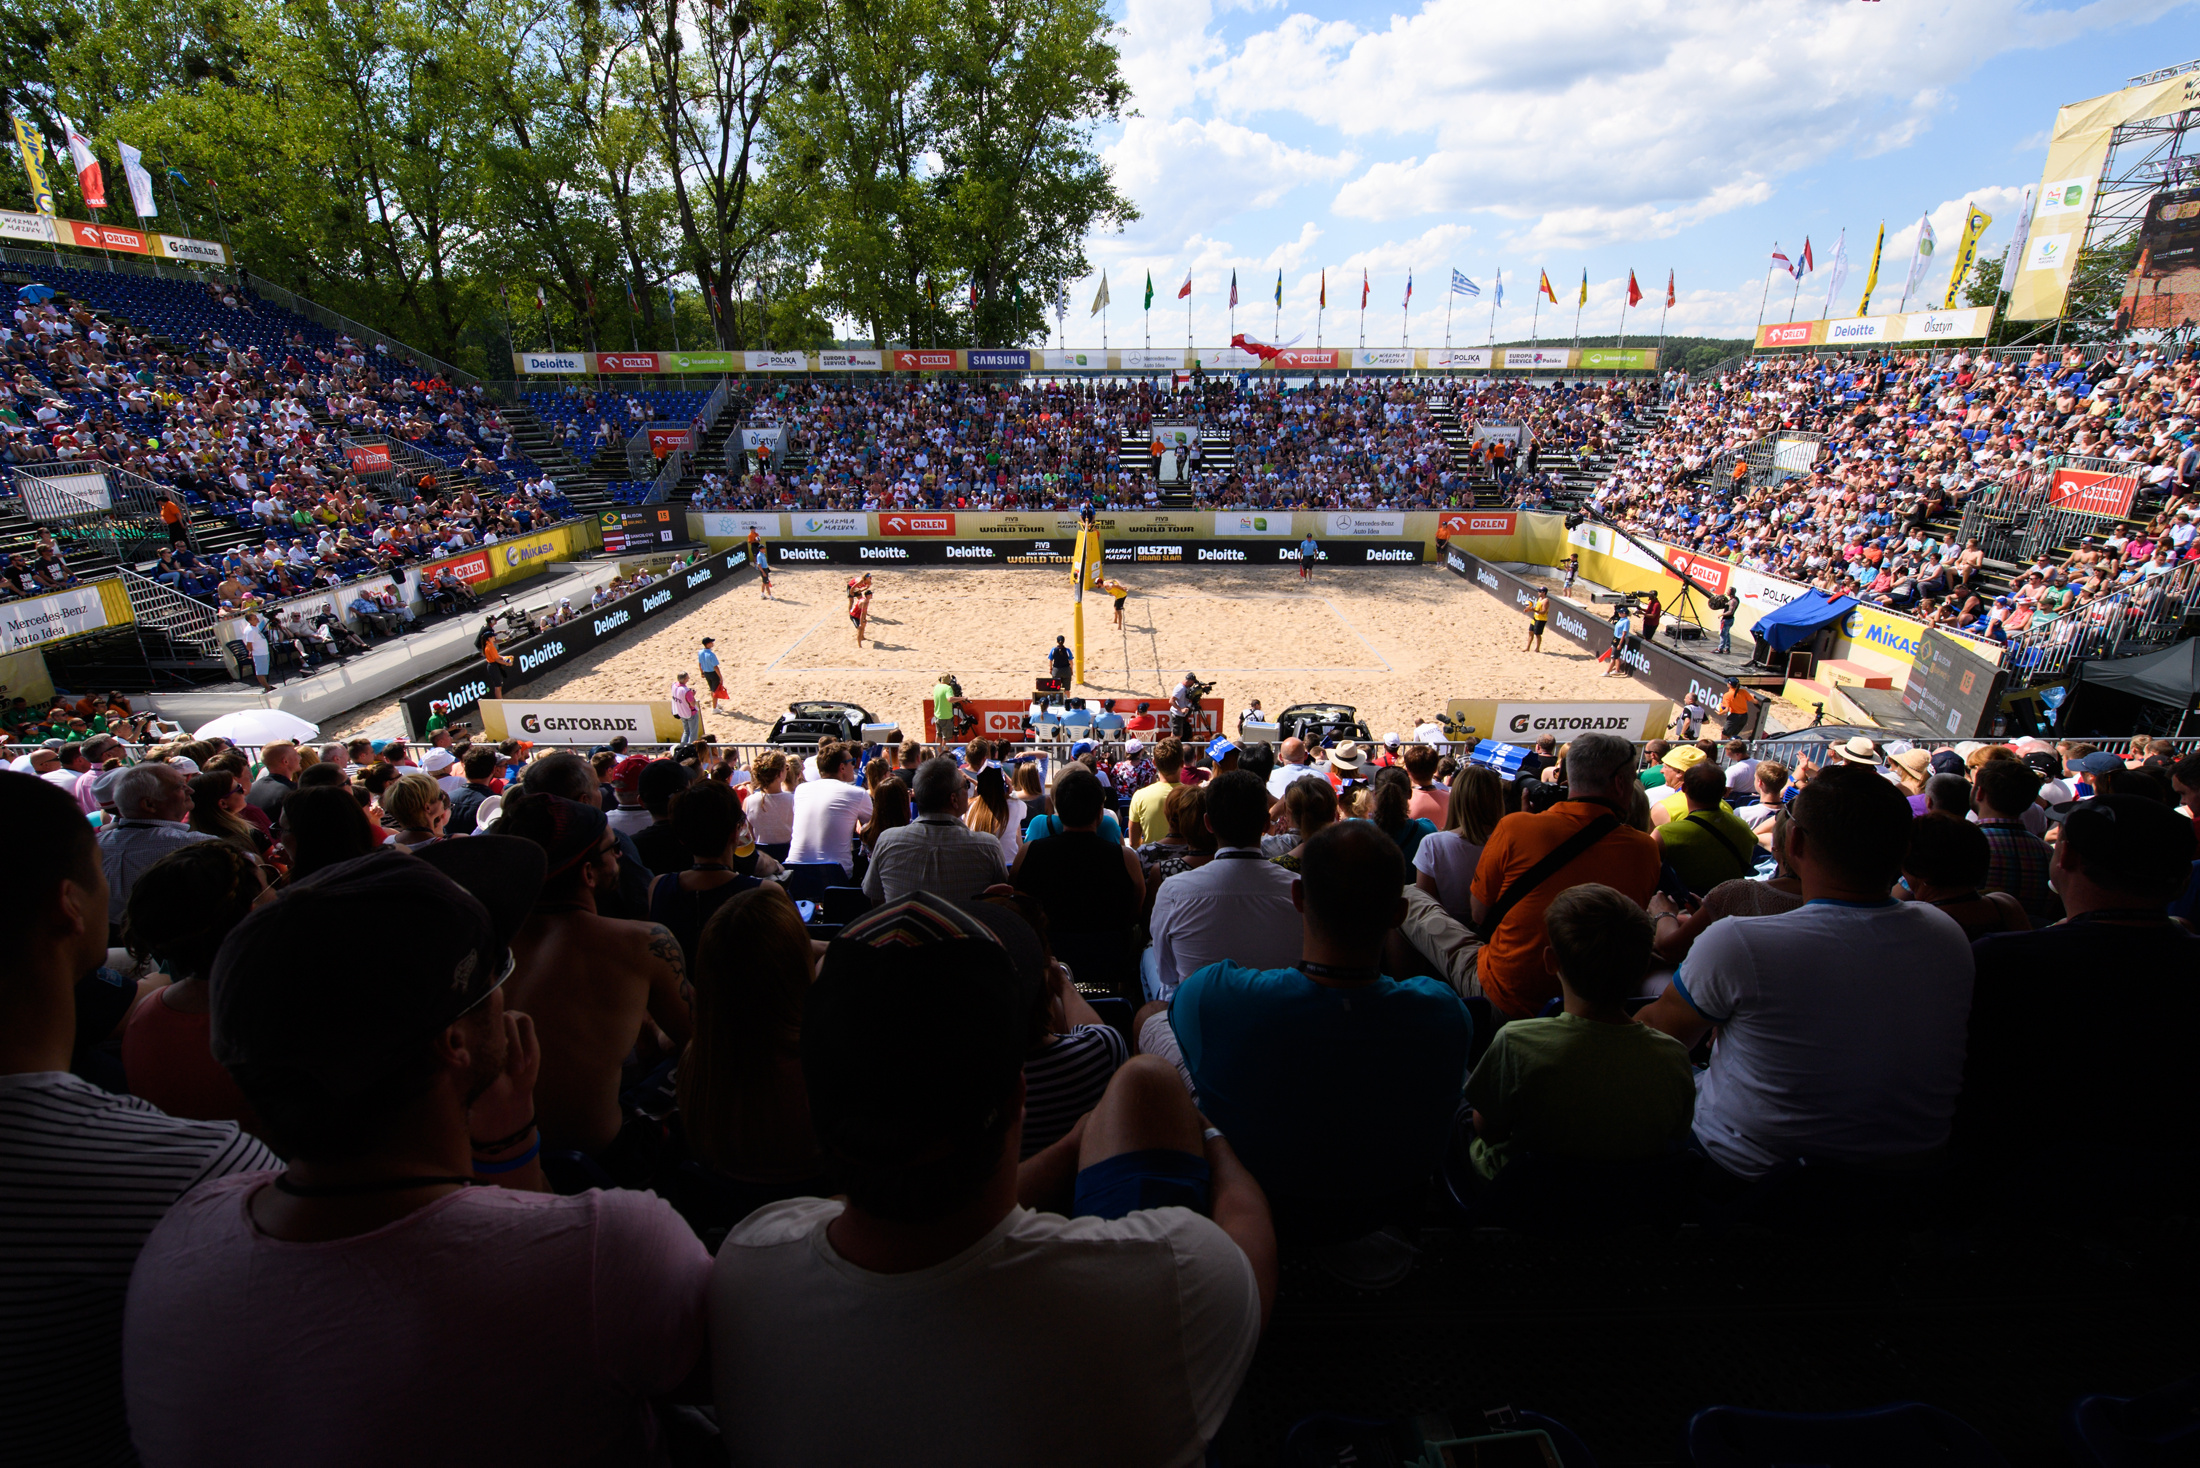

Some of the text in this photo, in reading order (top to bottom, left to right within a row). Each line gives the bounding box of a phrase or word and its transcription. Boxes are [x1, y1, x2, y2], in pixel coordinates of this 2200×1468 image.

[4, 217, 39, 227] WARMIA
[7, 225, 41, 234] MAZURY
[106, 233, 137, 246] ORLEN
[179, 244, 219, 256] GATORADE
[1924, 315, 1953, 333] Olsztyn
[1783, 330, 1805, 339] ORLEN
[1834, 324, 1877, 337] Deloitte.
[531, 358, 578, 369] Deloitte.
[921, 356, 949, 364] ORLEN
[973, 356, 1025, 365] SAMSUNG
[1302, 354, 1330, 362] ORLEN
[1454, 354, 1480, 362] POLSKA
[913, 521, 945, 529] ORLEN
[1473, 520, 1505, 528] ORLEN
[521, 543, 554, 561] MIKASA
[780, 548, 829, 560] Deloitte.
[860, 547, 909, 558] Deloitte.
[946, 546, 996, 558] Deloitte.
[1138, 545, 1182, 555] OLSZTYN
[1198, 548, 1247, 560] Deloitte.
[1366, 548, 1416, 561] Deloitte.
[1006, 556, 1047, 564] WORLD
[457, 561, 484, 578] ORLEN
[1692, 566, 1719, 583] ORLEN
[7, 605, 89, 632] Mercedes-Benz
[594, 609, 631, 637] Deloitte.
[1556, 611, 1588, 642] Deloitte.
[13, 626, 66, 647] Auto Idea
[1864, 624, 1920, 656] MIKAS
[519, 641, 566, 674] Deloitte.
[1963, 674, 1972, 689] 15
[544, 717, 638, 731] GATORADE
[1533, 717, 1629, 730] GATORADE
